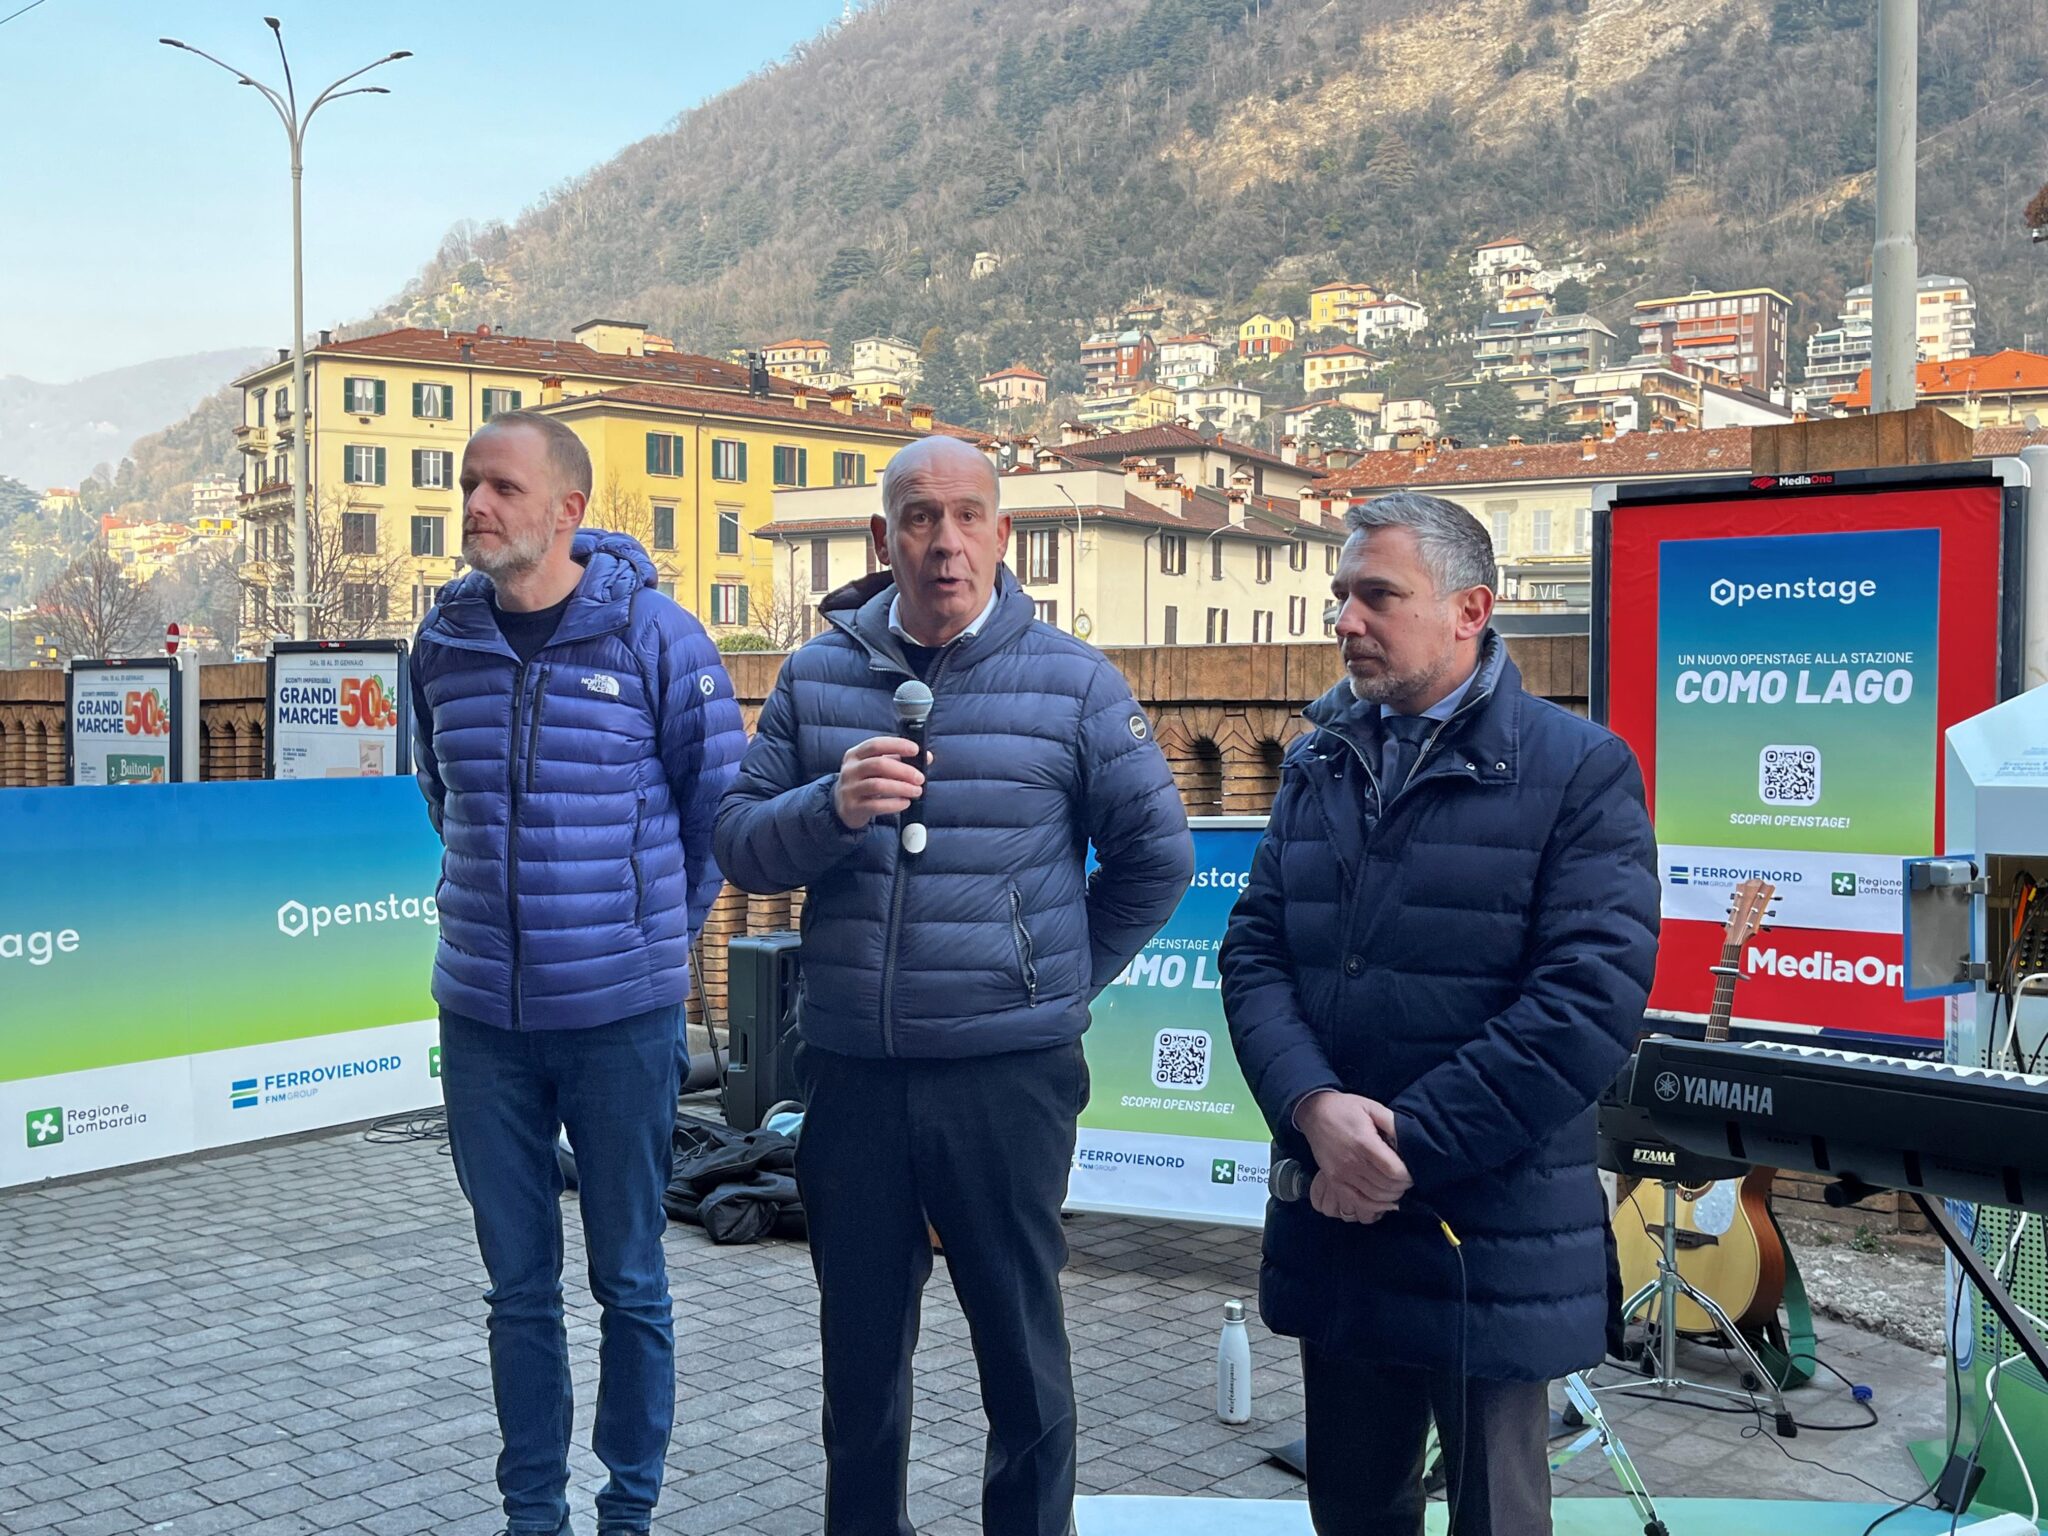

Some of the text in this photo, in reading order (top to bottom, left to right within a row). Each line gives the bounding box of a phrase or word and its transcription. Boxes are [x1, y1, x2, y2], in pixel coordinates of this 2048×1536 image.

[1779, 475, 1833, 486] MediaOne
[1678, 652, 1914, 665] UN NUOVO OPENSTAGE ALLA STAZIONE
[1675, 668, 1914, 704] COMO LAGO
[280, 687, 336, 704] GRANDI
[78, 700, 122, 715] GRANDI
[279, 707, 338, 725] MARCHE
[77, 718, 124, 733] MARCHE
[120, 759, 150, 776] Buitoni
[1730, 813, 1850, 829] SCOPRI OPENSTAGE!
[1693, 866, 1802, 882] FERROVIENORD
[1858, 876, 1902, 887] Regione
[1192, 956, 1222, 989] L
[265, 1056, 401, 1090] FERROVIENORD
[1683, 1075, 1773, 1116] YAMAHA
[68, 1104, 129, 1122] Regione
[1120, 1095, 1235, 1114] SCOPRI OPENSTAGE!
[68, 1113, 147, 1135] Lombardia
[1079, 1149, 1184, 1168] FERROVIENORD
[1641, 1150, 1676, 1163] TAMA
